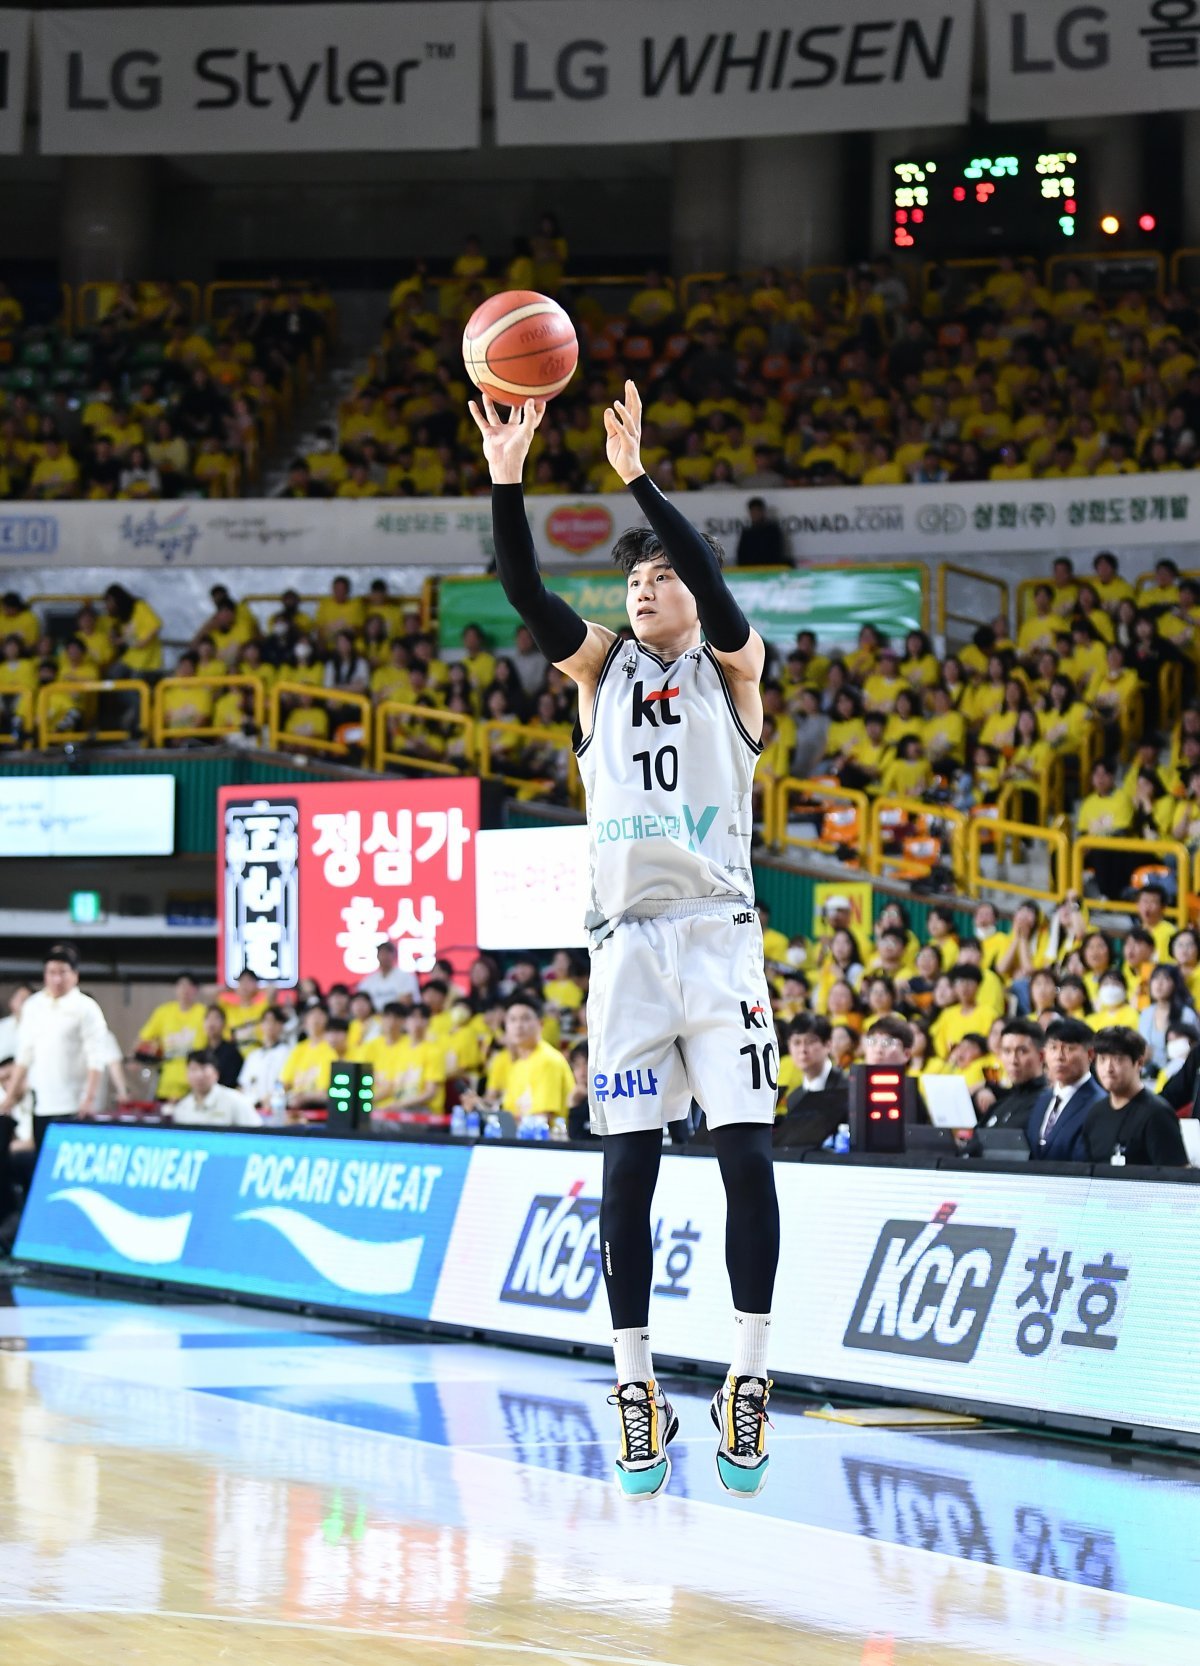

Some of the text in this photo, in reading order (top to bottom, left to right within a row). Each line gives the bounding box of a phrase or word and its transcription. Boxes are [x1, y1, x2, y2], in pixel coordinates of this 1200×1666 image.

[511, 16, 953, 101] LG WHISEN
[1011, 7, 1110, 75] LG
[67, 49, 162, 111] LG
[194, 46, 420, 122] Styler
[632, 681, 681, 728] kt
[632, 745, 679, 792] 10
[312, 807, 471, 888] 정심가
[335, 895, 444, 974] 홍삼
[593, 1068, 659, 1102] 유사나
[740, 1042, 779, 1091] 10
[52, 1141, 208, 1192] POCARI SWEAT
[239, 1153, 443, 1214] POCARI SWEAT
[652, 1218, 702, 1299] 호
[862, 1203, 993, 1347] KCC
[1014, 1247, 1129, 1357] 창호
